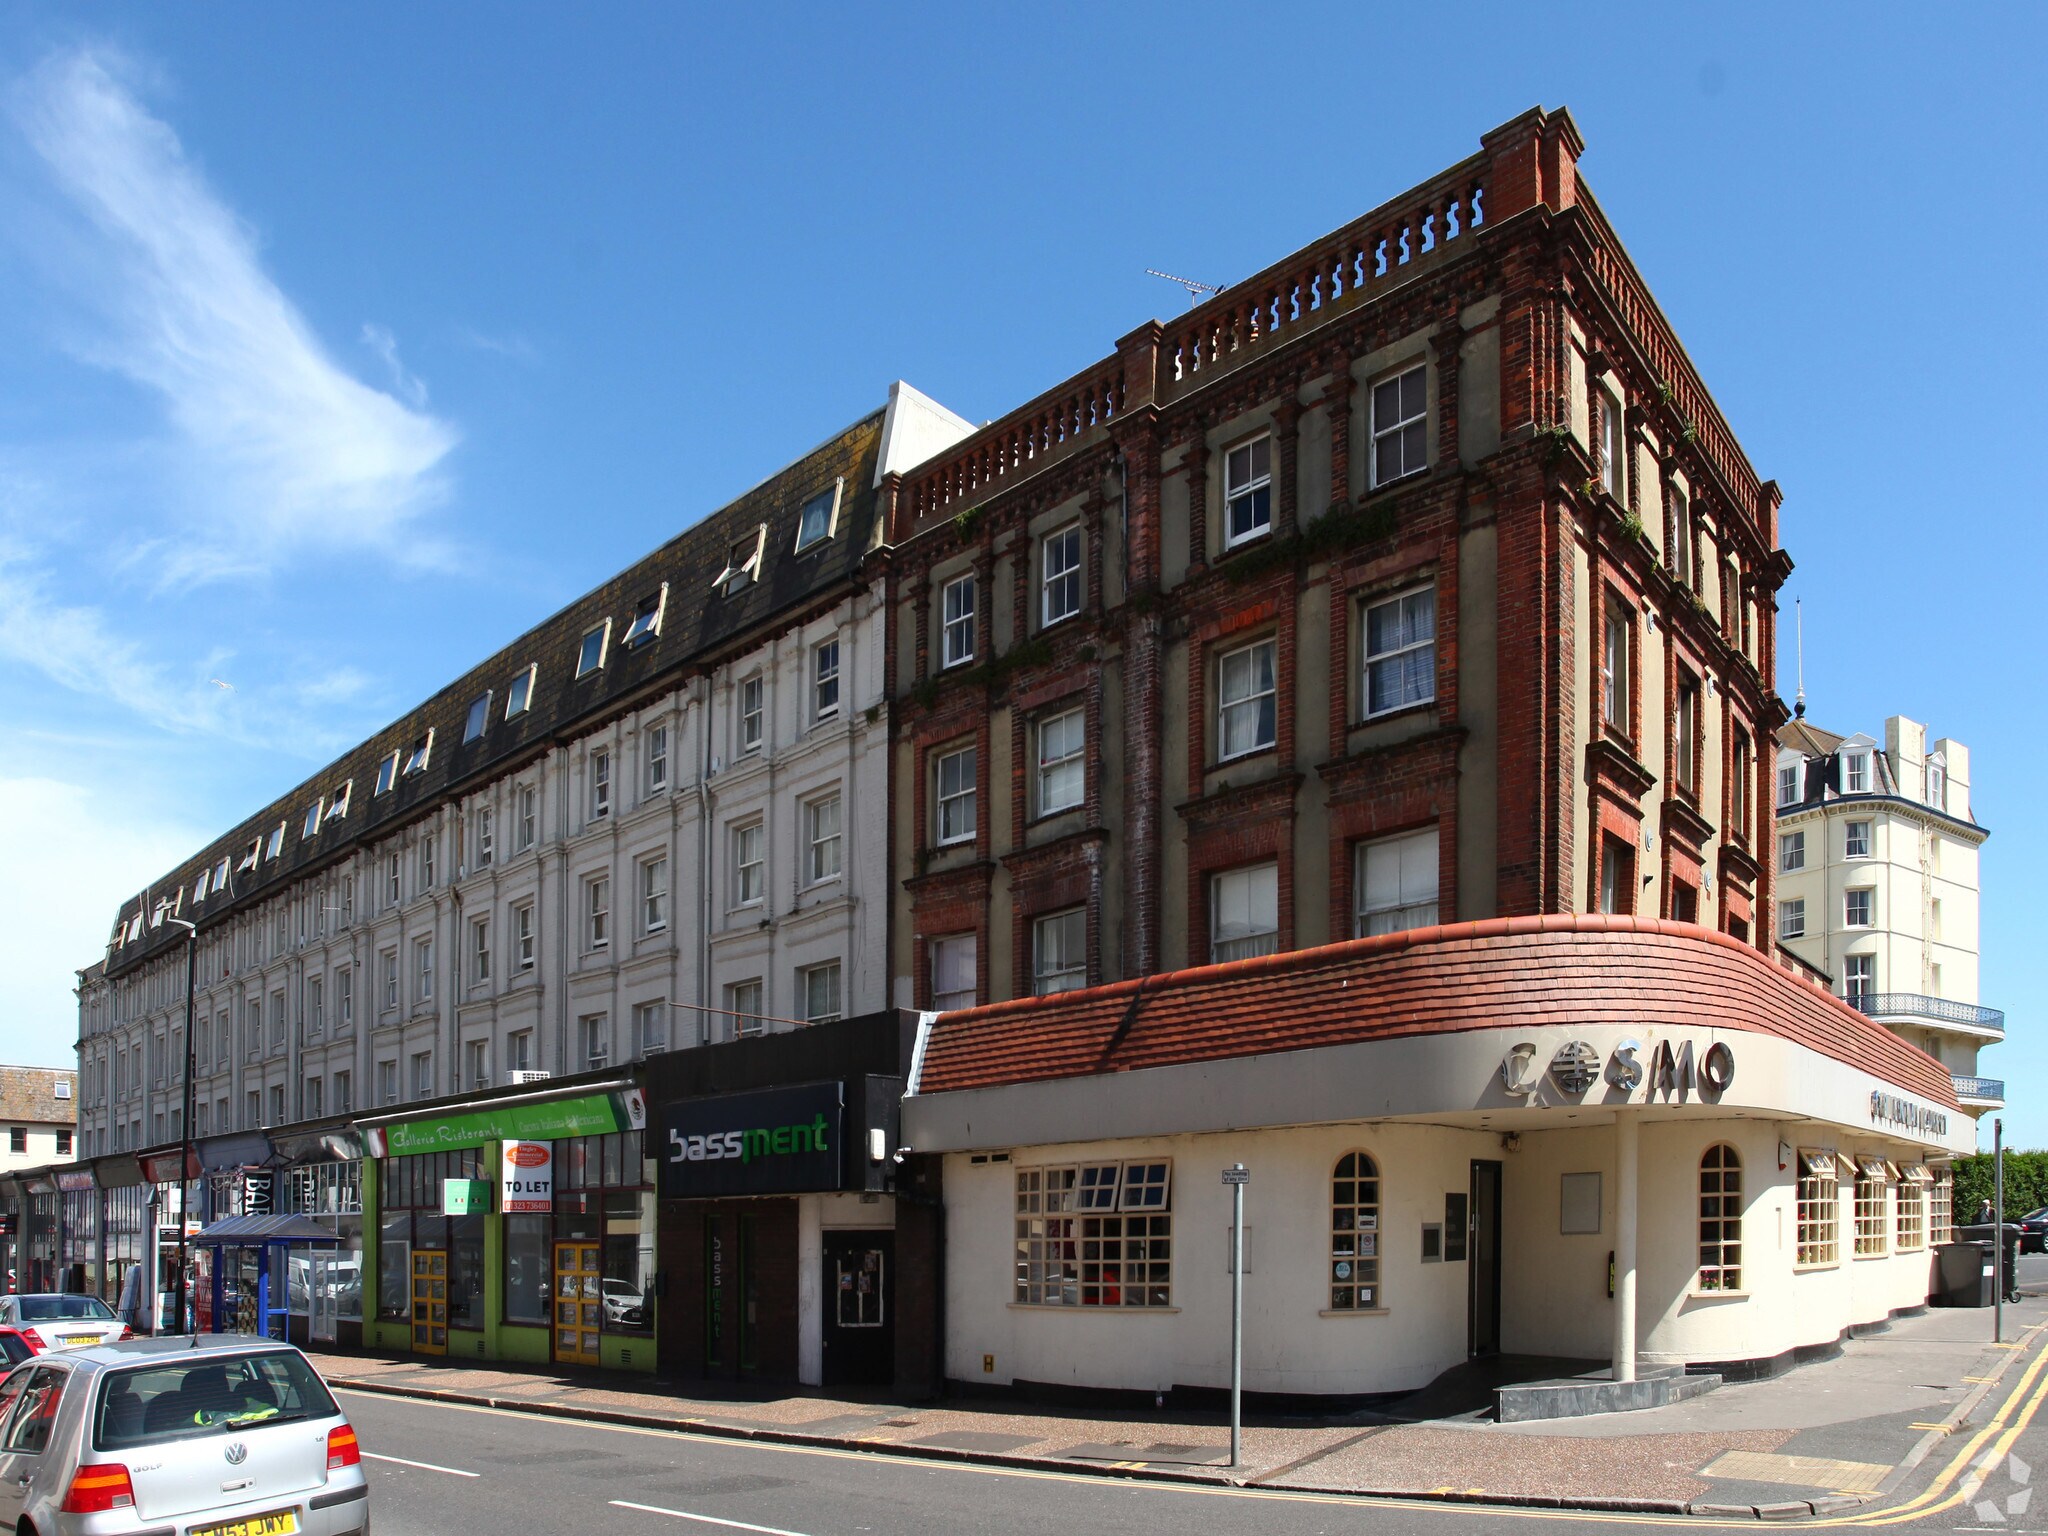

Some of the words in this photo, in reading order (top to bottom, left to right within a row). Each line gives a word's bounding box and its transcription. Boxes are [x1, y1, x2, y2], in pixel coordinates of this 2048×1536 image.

[1502, 1039, 1735, 1094] COSMO
[392, 1128, 435, 1148] Galleria
[436, 1122, 504, 1143] Ristorante
[669, 1112, 829, 1164] bassment
[505, 1181, 522, 1193] TO
[526, 1181, 550, 1193] LET
[505, 1201, 525, 1210] 01323
[133, 1463, 162, 1473] GOLF
[255, 1514, 285, 1535] JWY
